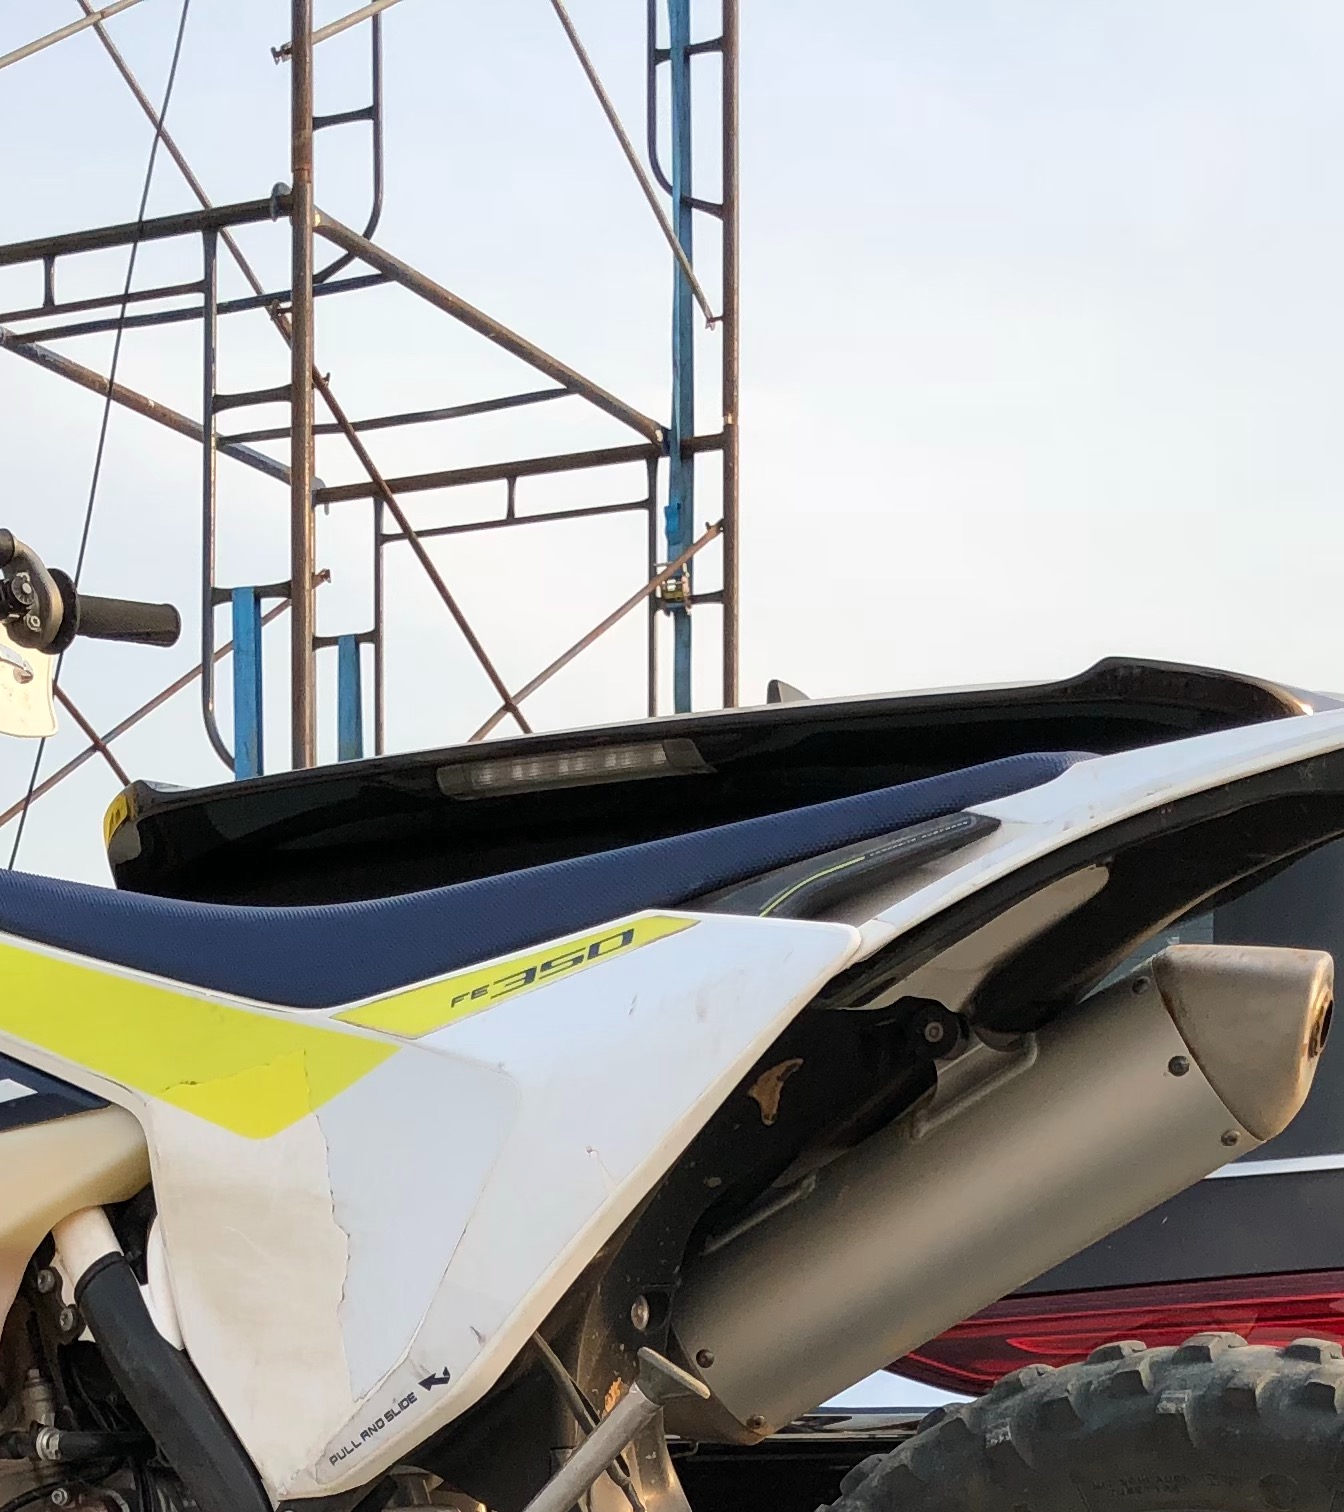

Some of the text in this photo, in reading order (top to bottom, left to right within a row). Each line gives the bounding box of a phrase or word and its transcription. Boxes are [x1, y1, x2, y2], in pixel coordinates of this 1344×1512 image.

[329, 1391, 418, 1466] PULL AND SLIDE
